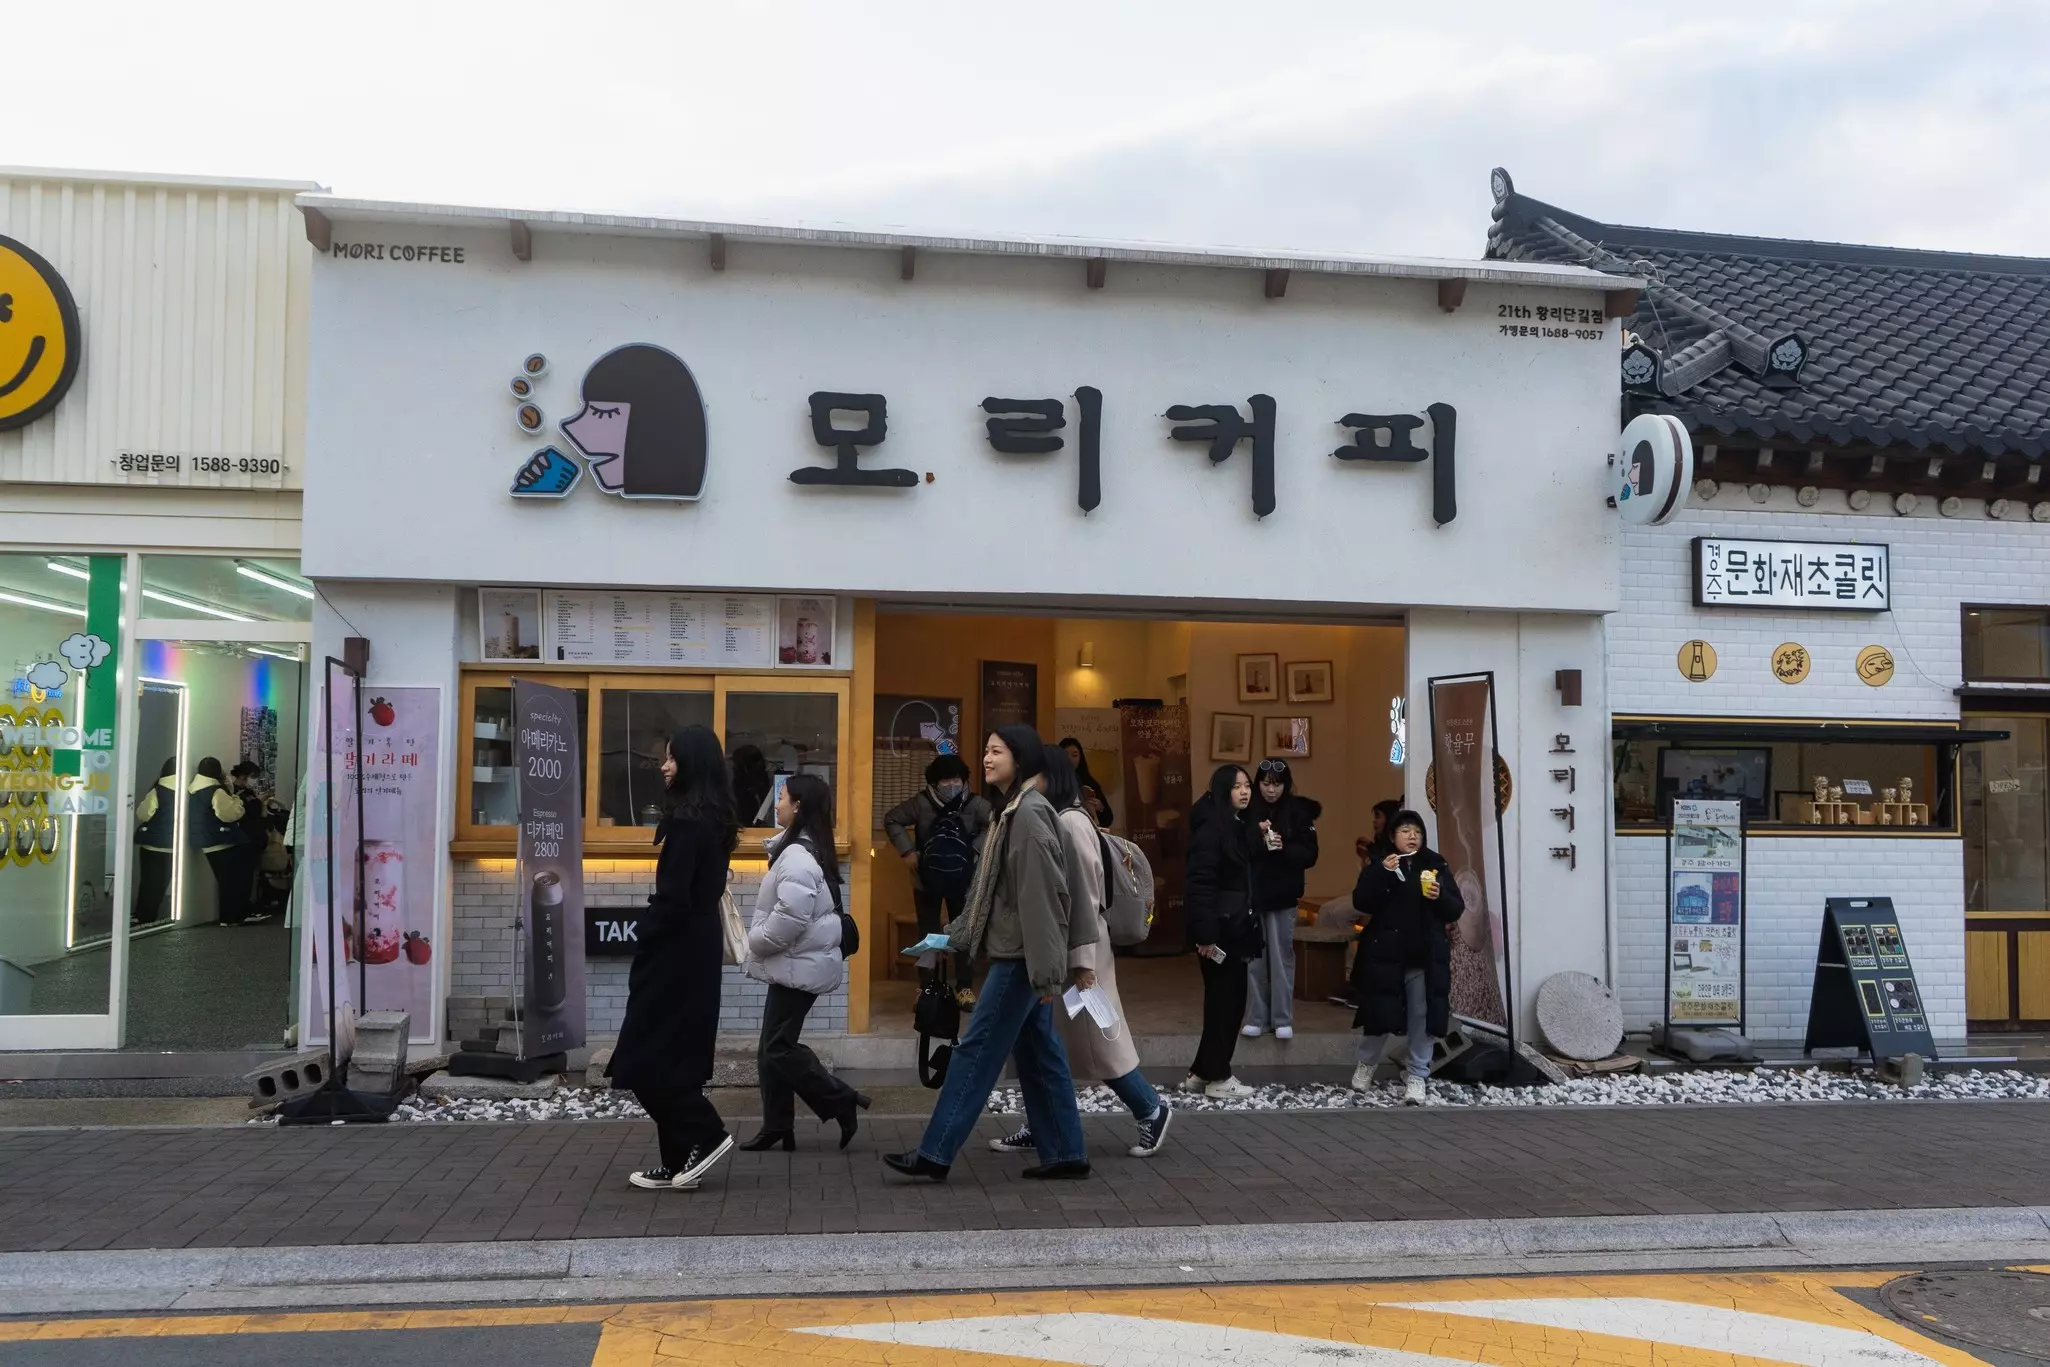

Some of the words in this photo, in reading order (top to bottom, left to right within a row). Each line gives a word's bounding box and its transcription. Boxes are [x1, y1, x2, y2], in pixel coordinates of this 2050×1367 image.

[333, 242, 385, 260] MORI
[389, 244, 465, 263] COFFEE
[1498, 304, 1532, 319] 21th
[1535, 306, 1603, 324] 황리단길점
[1499, 324, 1539, 339] 가맹문의
[1541, 327, 1604, 341] 1688-9057
[119, 453, 180, 473] 창업문의
[191, 456, 280, 474] 1588-9390
[787, 385, 1458, 528] 모리커피
[1706, 544, 1722, 600] 경주
[1725, 550, 1884, 600] 문화재초콜릿
[530, 711, 562, 727] specialty
[2, 726, 113, 747] WELCOME
[521, 728, 568, 752] 아메리카노
[81, 750, 111, 770] TO
[528, 756, 562, 780] 2000
[48, 796, 109, 813] LAND
[1549, 732, 1576, 872] 모리커피
[533, 808, 557, 818] Espresso
[526, 821, 564, 840] 디카페인
[534, 841, 559, 857] 2800
[595, 920, 639, 943] TAK
